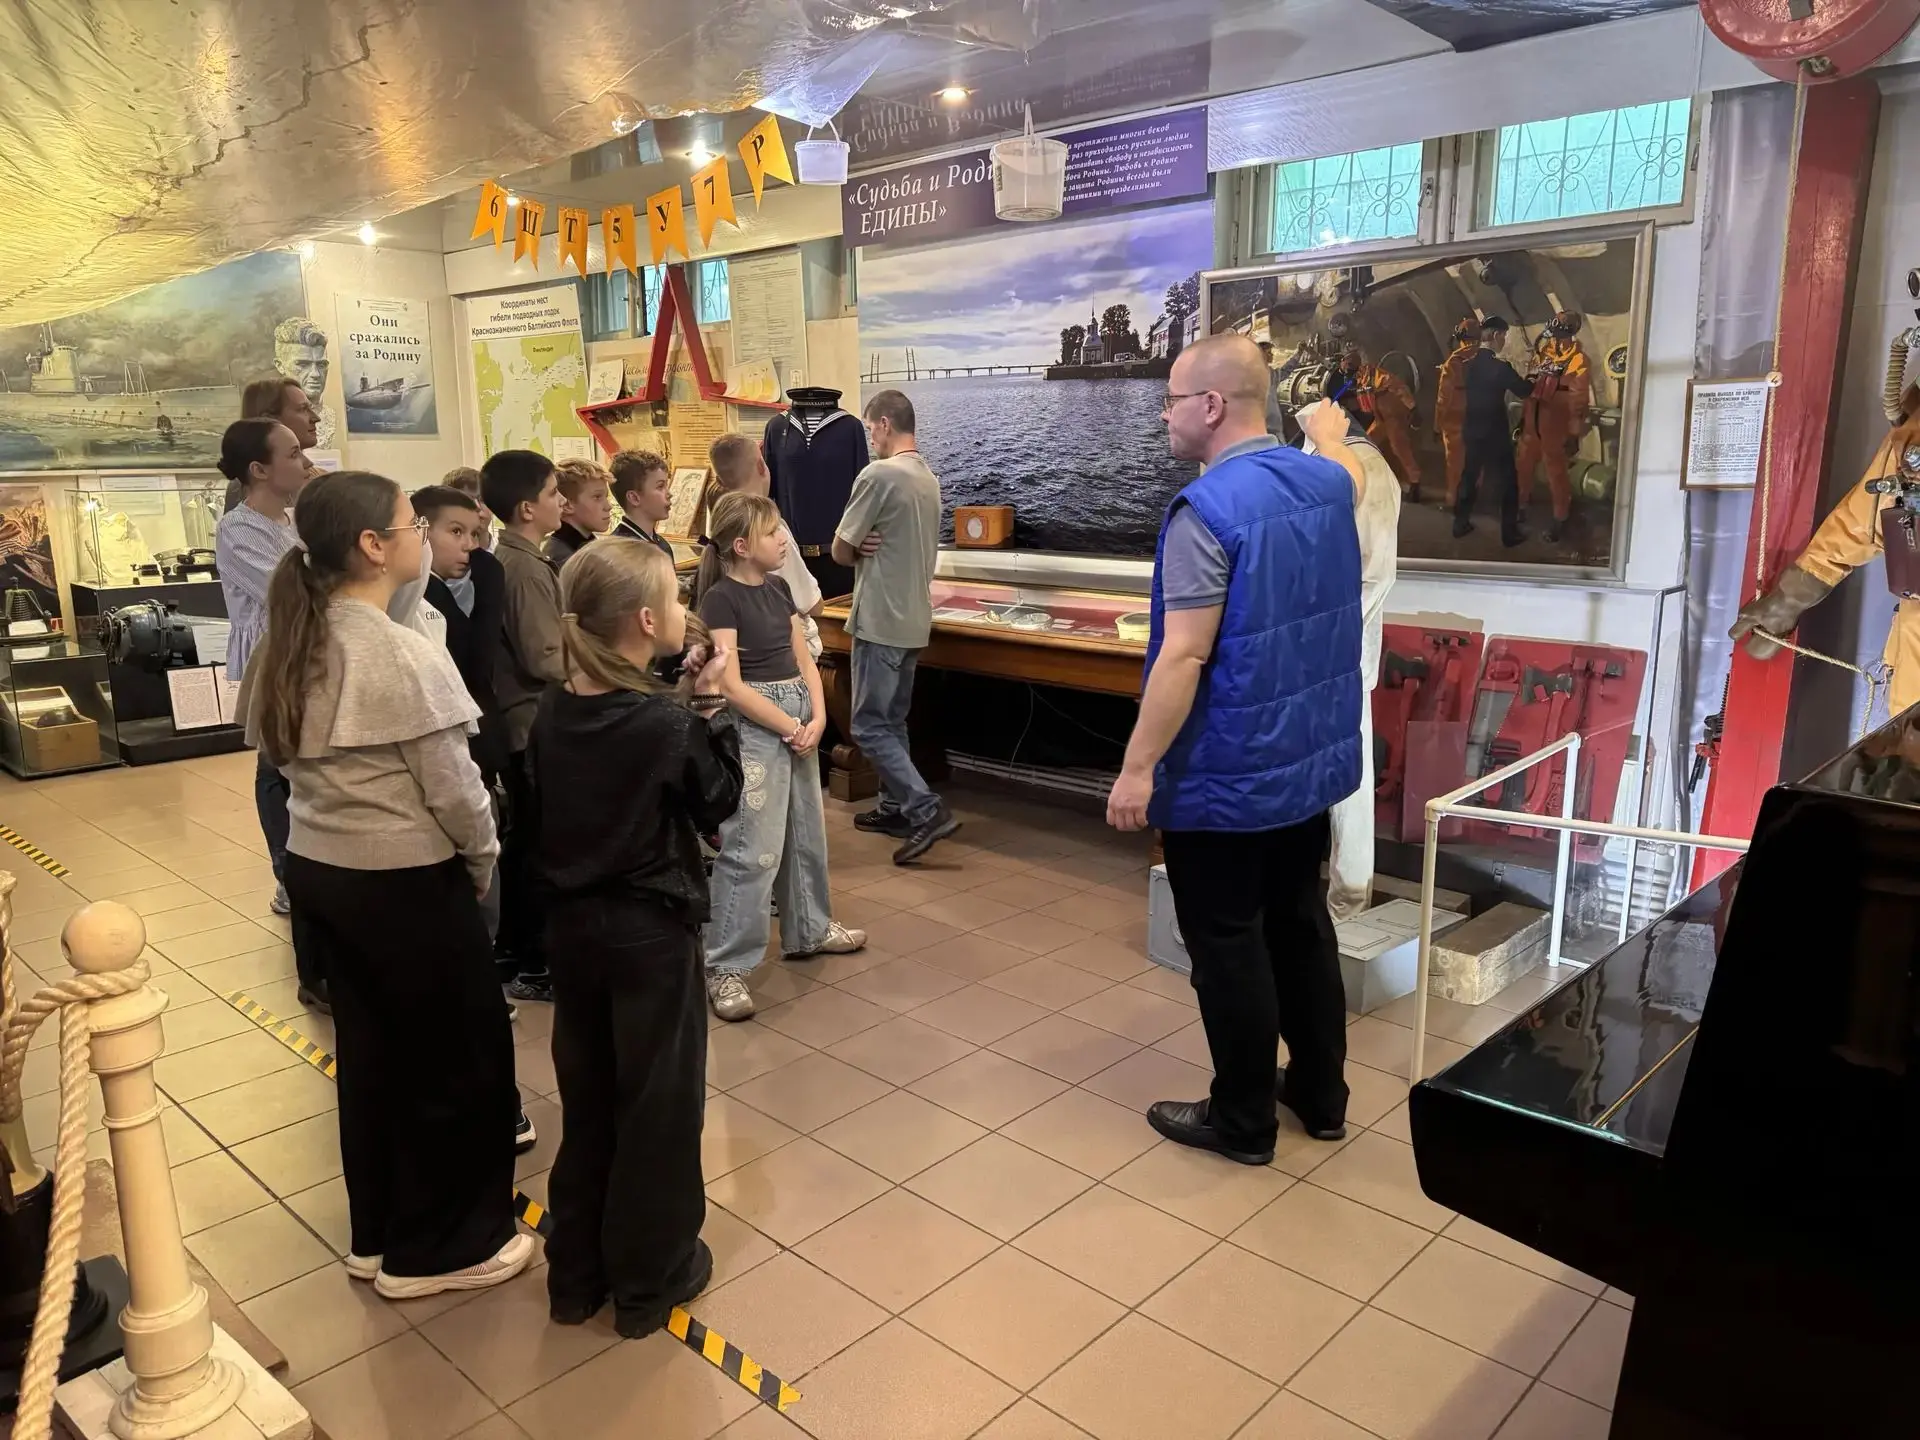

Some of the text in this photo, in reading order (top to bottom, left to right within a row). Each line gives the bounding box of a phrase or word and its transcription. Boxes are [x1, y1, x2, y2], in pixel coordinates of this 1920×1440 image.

[1074, 135, 1118, 151] протяжении
[1120, 129, 1147, 140] многих
[1148, 123, 1170, 135] веков
[1085, 144, 1129, 159] приходилось
[1130, 137, 1162, 151] русским
[1164, 133, 1190, 143] людям
[1105, 153, 1132, 165] свободу
[1139, 143, 1194, 158] независимость
[1114, 161, 1142, 173] Любовь
[1151, 156, 1179, 166] Родине
[1097, 176, 1125, 187] Родины
[1126, 170, 1150, 181] всегда
[1152, 168, 1172, 178] были
[849, 172, 923, 211] «Судьба
[929, 173, 941, 191] и
[860, 200, 947, 238] ЕДИНЫ»
[501, 299, 536, 309] Координаты
[370, 314, 398, 328] Они
[490, 308, 560, 322] гибели подводных лодок
[472, 318, 579, 337] Краснознаменного Балтийского Флота
[350, 333, 421, 345] сражались
[356, 349, 421, 364] за Родину
